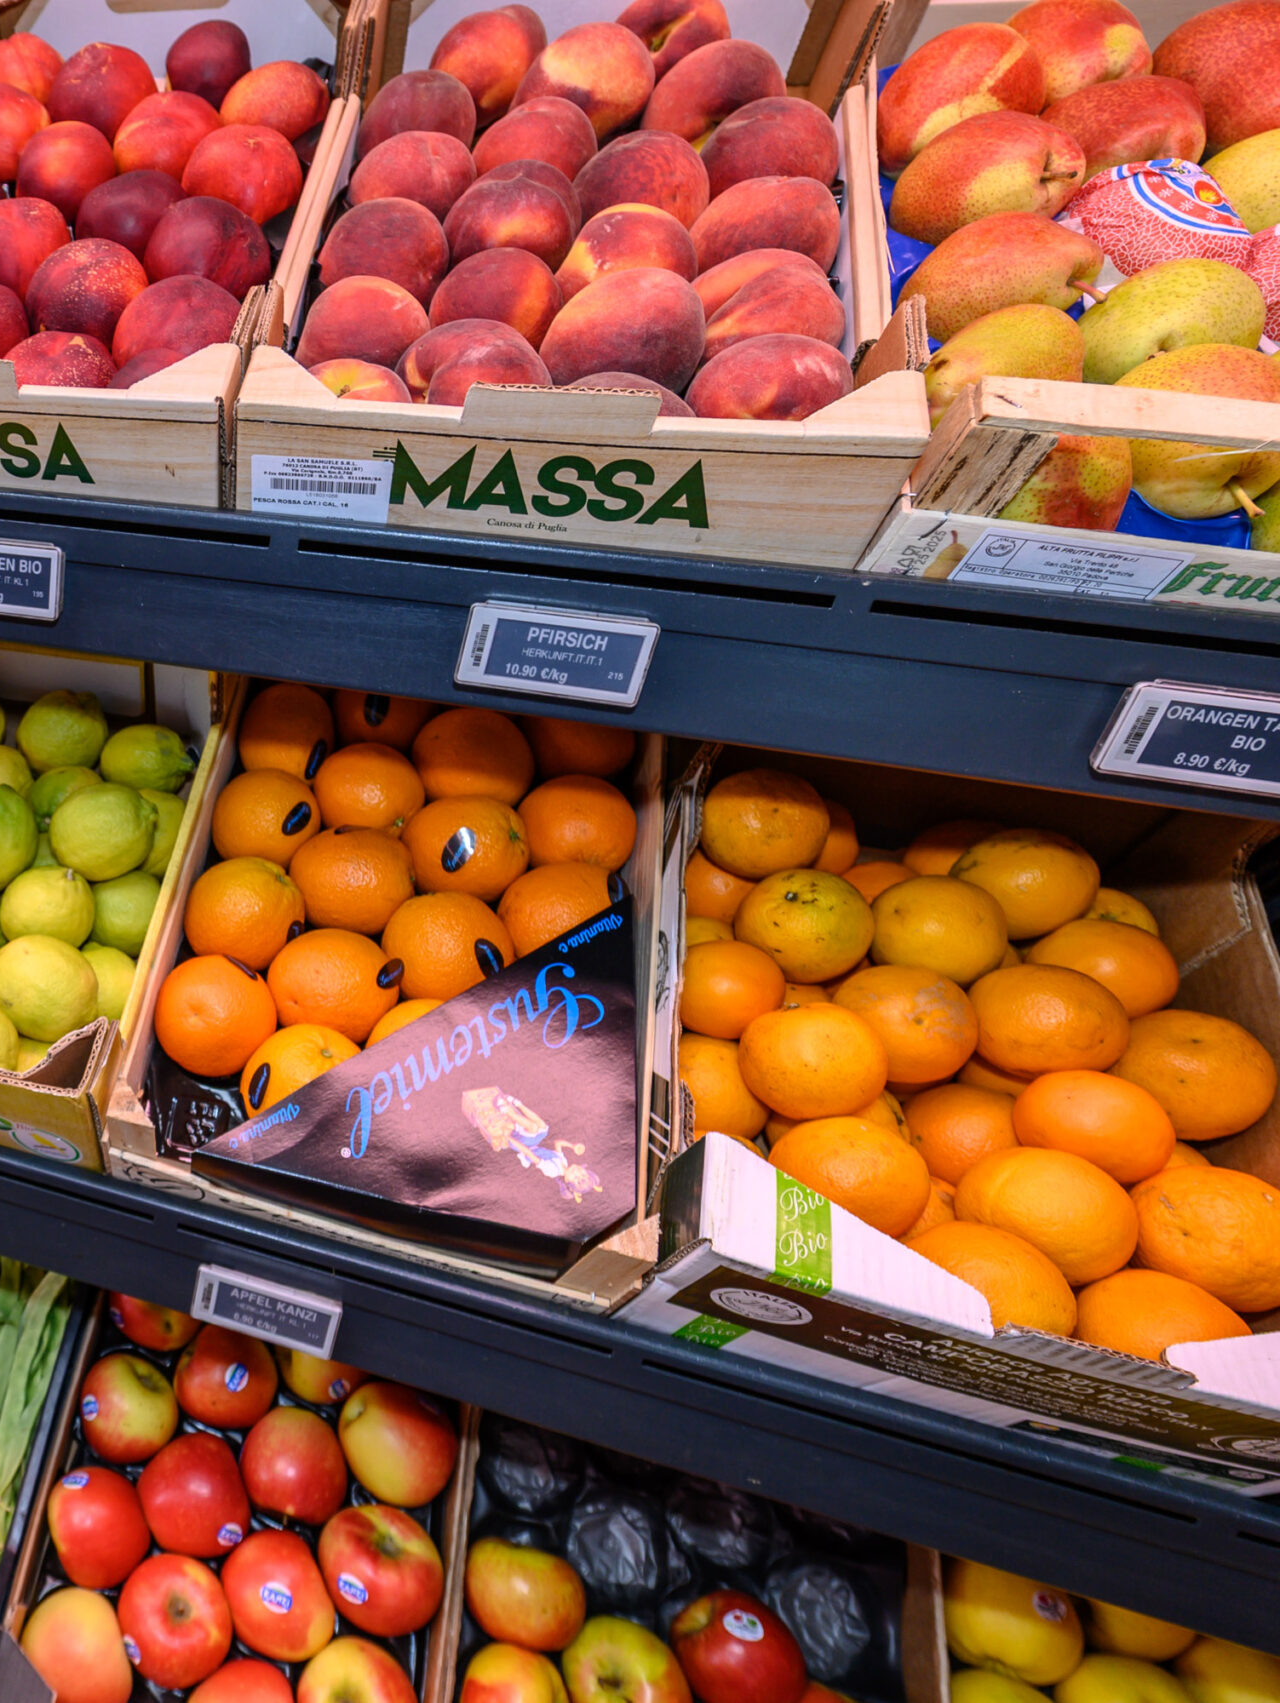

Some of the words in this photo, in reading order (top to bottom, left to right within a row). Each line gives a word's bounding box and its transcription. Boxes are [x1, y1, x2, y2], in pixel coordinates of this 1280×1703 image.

[391, 438, 710, 530] MASSA
[486, 518, 522, 528] Canosa
[524, 521, 535, 530] di
[537, 522, 567, 533] Puglia
[19, 559, 42, 575] BIO
[527, 626, 608, 652] PFIRSICH
[505, 662, 537, 678] 10.90
[540, 667, 568, 685] €/kg
[1167, 705, 1258, 730] ORANGEN
[1231, 734, 1267, 752] BIO
[1173, 752, 1210, 769] 8.90
[1213, 758, 1251, 776] €/kg
[568, 913, 623, 947] Vitamina
[346, 962, 604, 1159] Gustemiel
[241, 1102, 300, 1142] Vitamina
[780, 1186, 825, 1222] Bio
[779, 1230, 827, 1266] Bio
[230, 1287, 272, 1309] APFEL
[276, 1301, 318, 1323] KANZI
[256, 1319, 278, 1334] €/kg
[883, 1333, 1095, 1394] CAMPOBASSO
[1098, 1393, 1190, 1419] Marco
[932, 1339, 1046, 1373] Azienda
[1049, 1371, 1174, 1406] Agricola
[262, 1585, 293, 1609] KANZI
